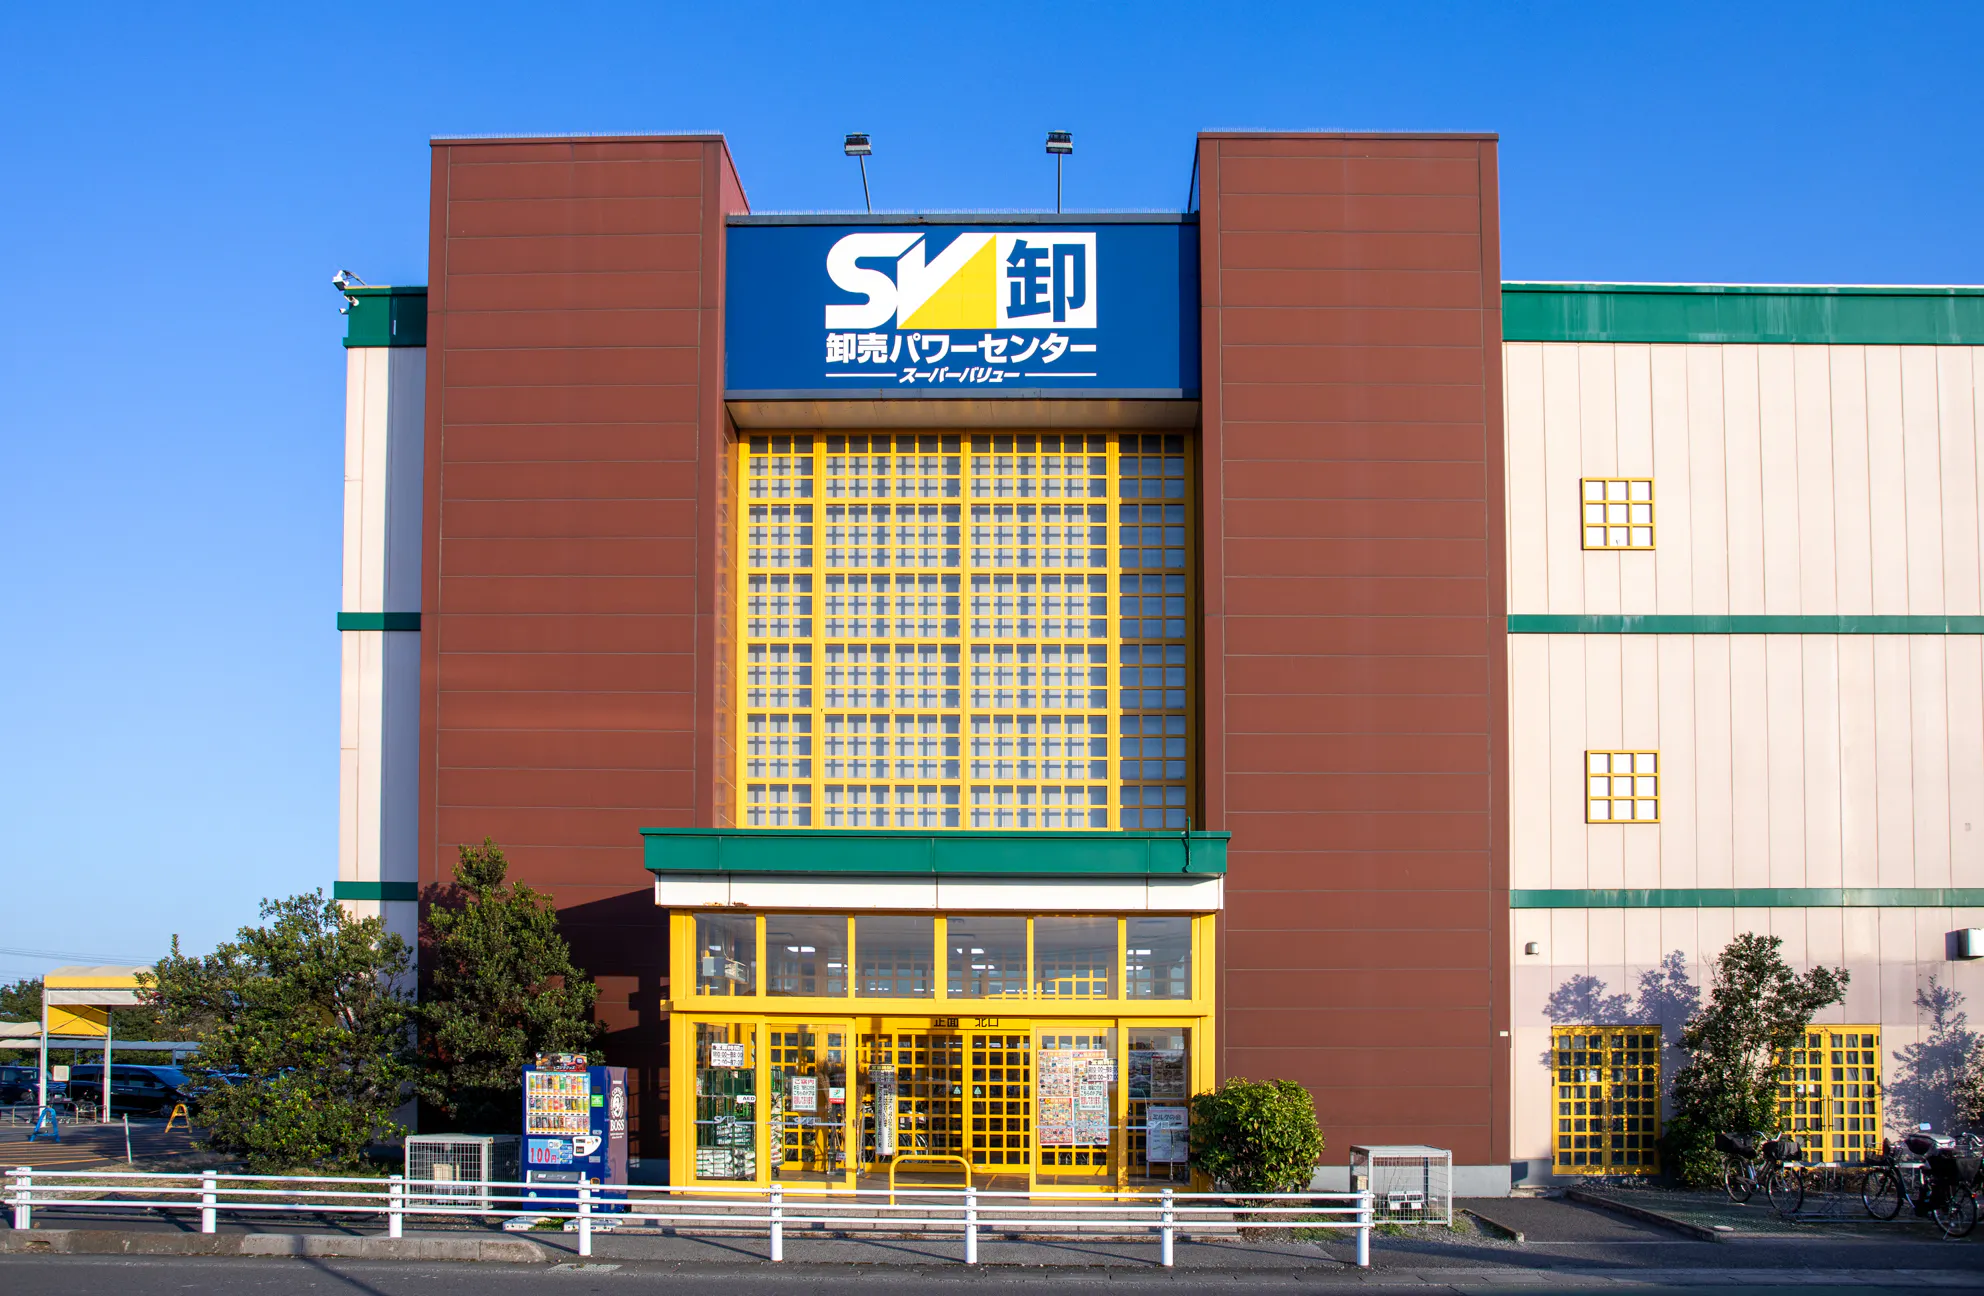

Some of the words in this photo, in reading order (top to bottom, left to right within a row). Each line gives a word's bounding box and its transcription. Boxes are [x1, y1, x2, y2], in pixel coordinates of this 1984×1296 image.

[1006, 239, 1086, 323] 卸
[825, 332, 1097, 364] 卸売パワーセンター
[899, 367, 1021, 383] スーパーバリュー
[975, 1017, 999, 1027] 北口
[610, 1119, 624, 1131] BOSS
